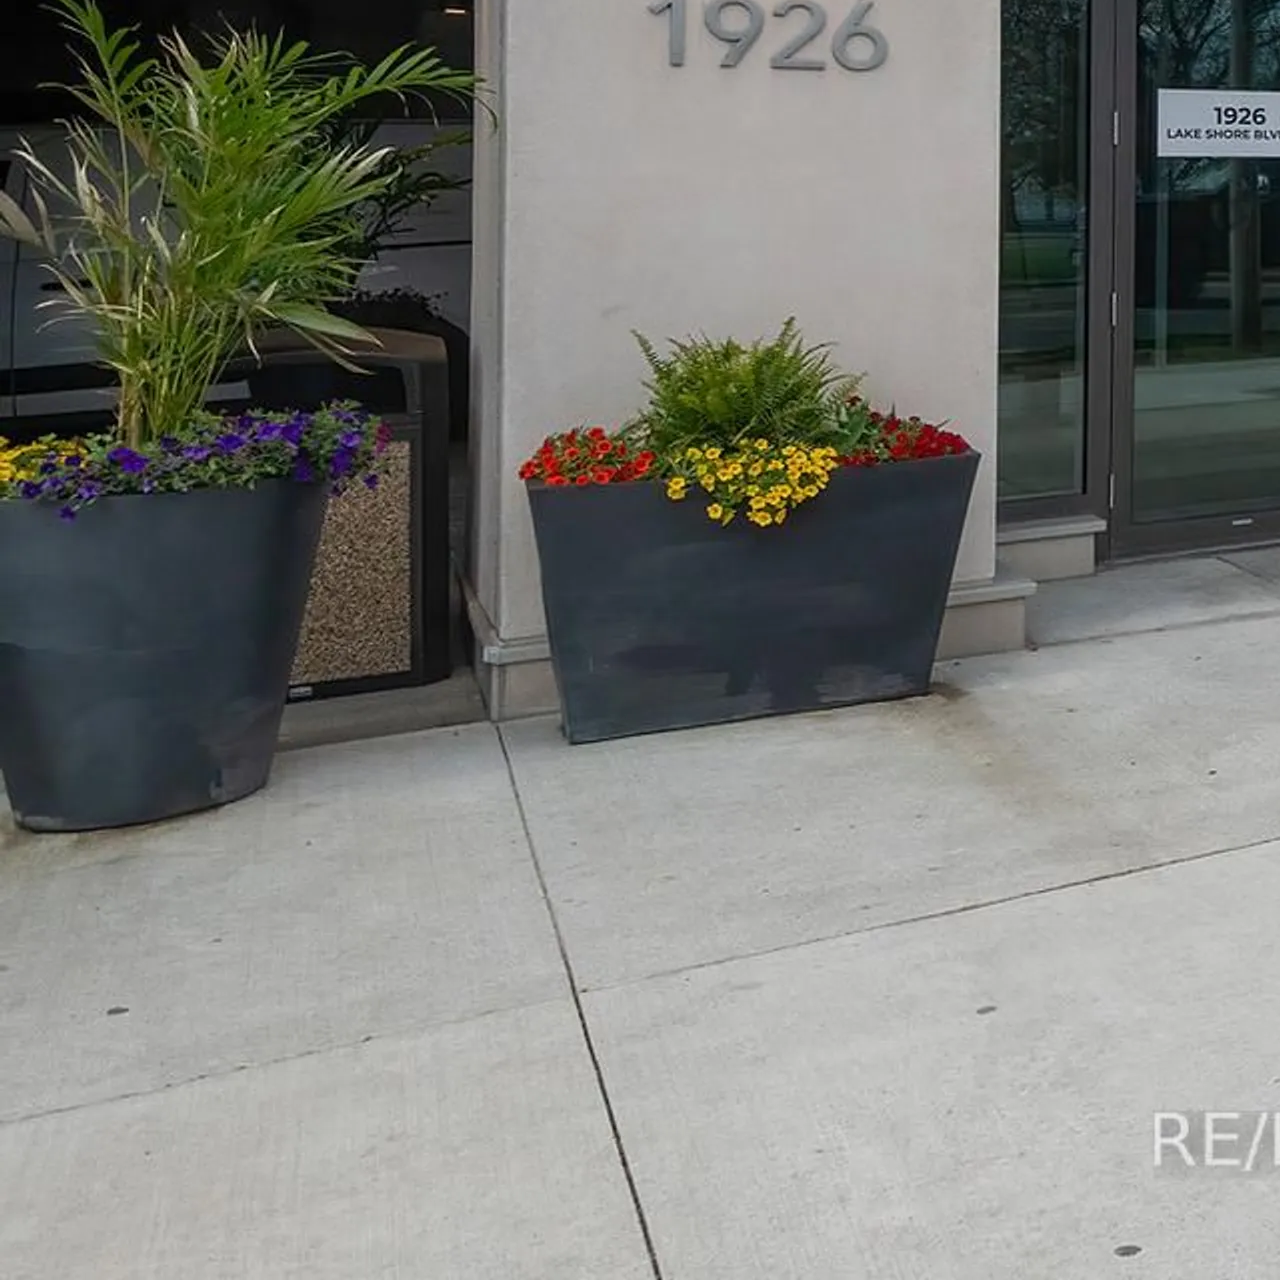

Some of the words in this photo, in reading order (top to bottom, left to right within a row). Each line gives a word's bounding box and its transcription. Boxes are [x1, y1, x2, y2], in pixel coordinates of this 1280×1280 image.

[1214, 107, 1267, 126] 1926
[1166, 128, 1201, 140] LAKE
[1205, 128, 1250, 140] SHORE
